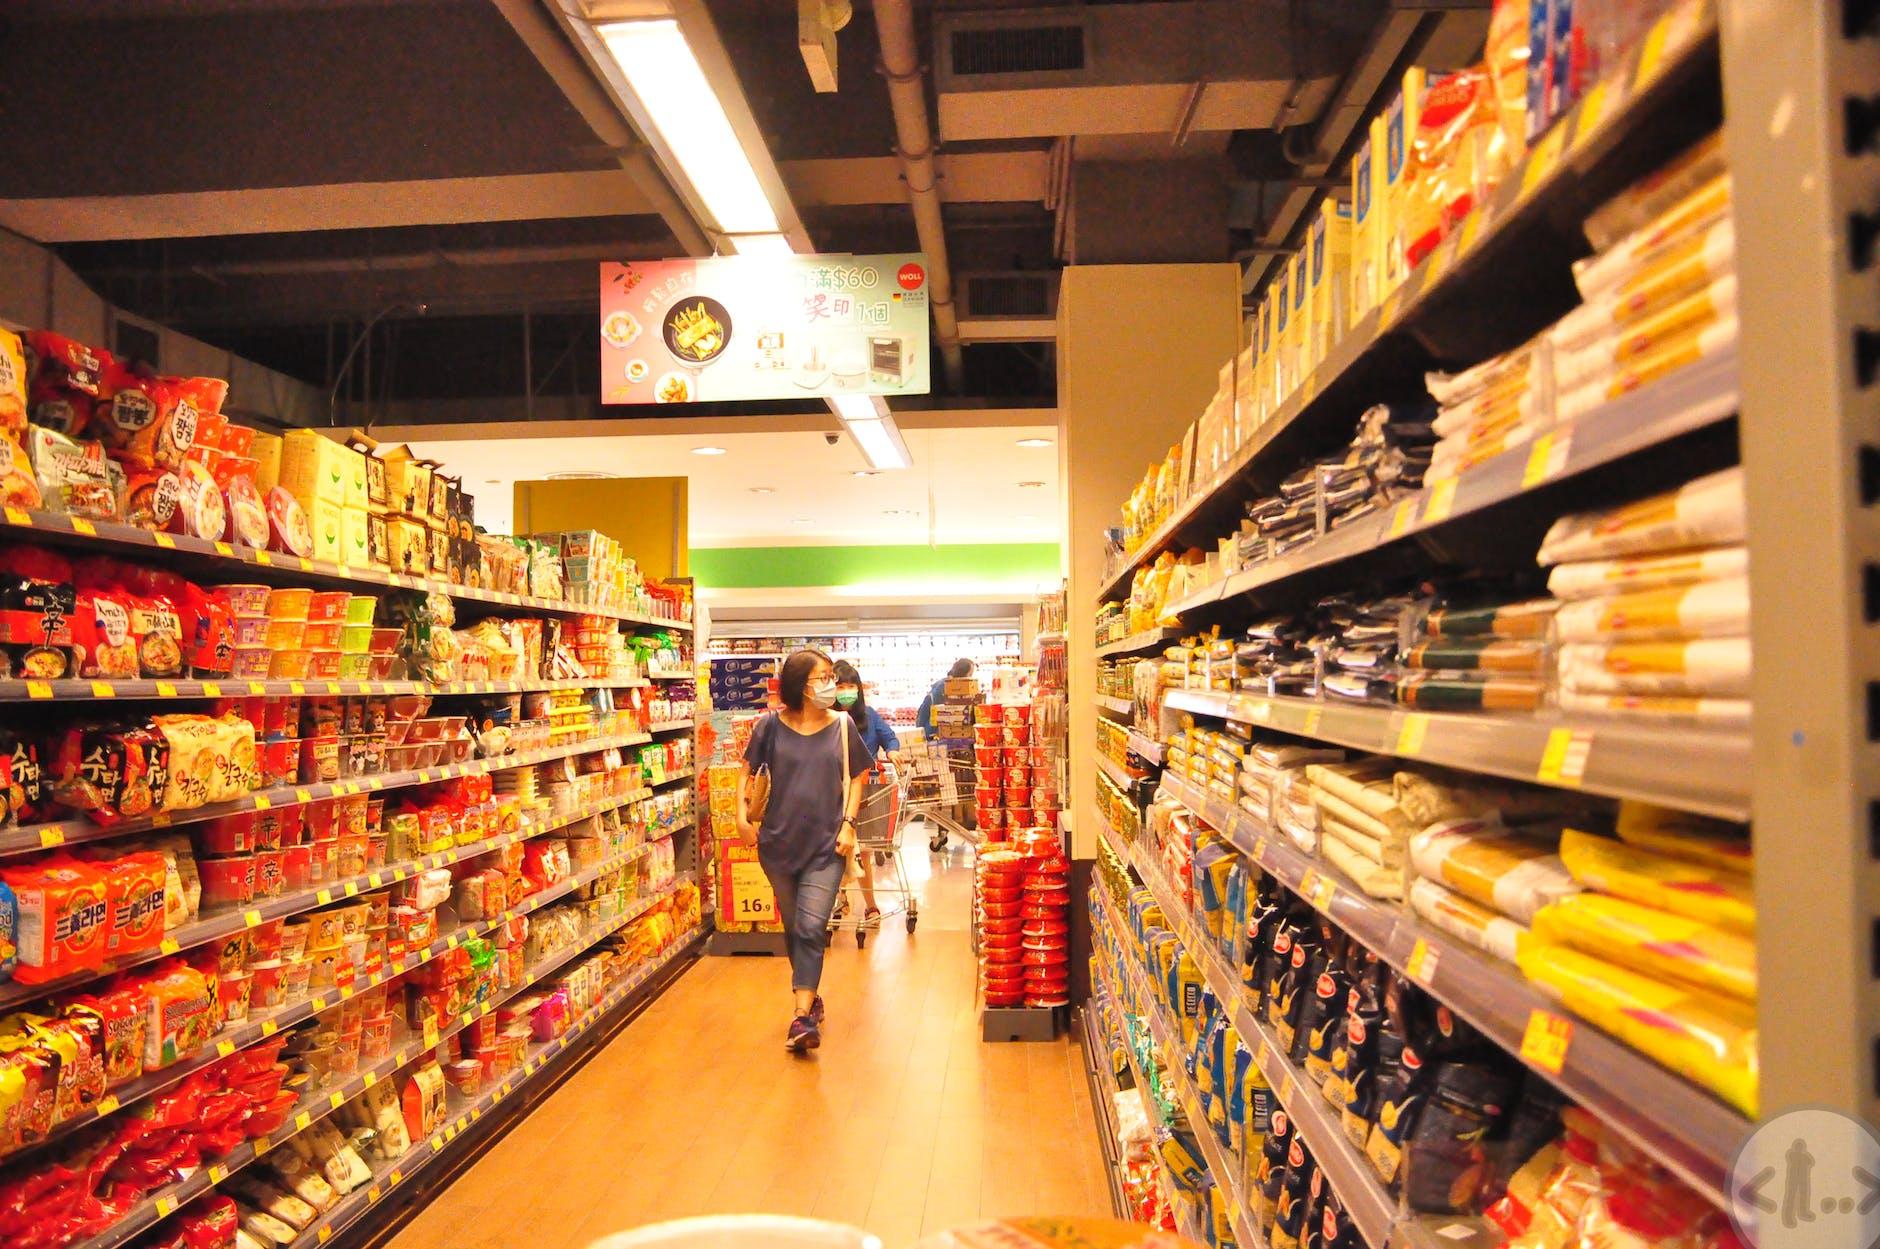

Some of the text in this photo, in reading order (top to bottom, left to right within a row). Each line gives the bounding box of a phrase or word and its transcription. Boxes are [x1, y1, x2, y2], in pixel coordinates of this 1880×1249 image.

[899, 273, 922, 281] WOLL
[41, 600, 67, 649] 辛
[741, 899, 771, 913] 16.9
